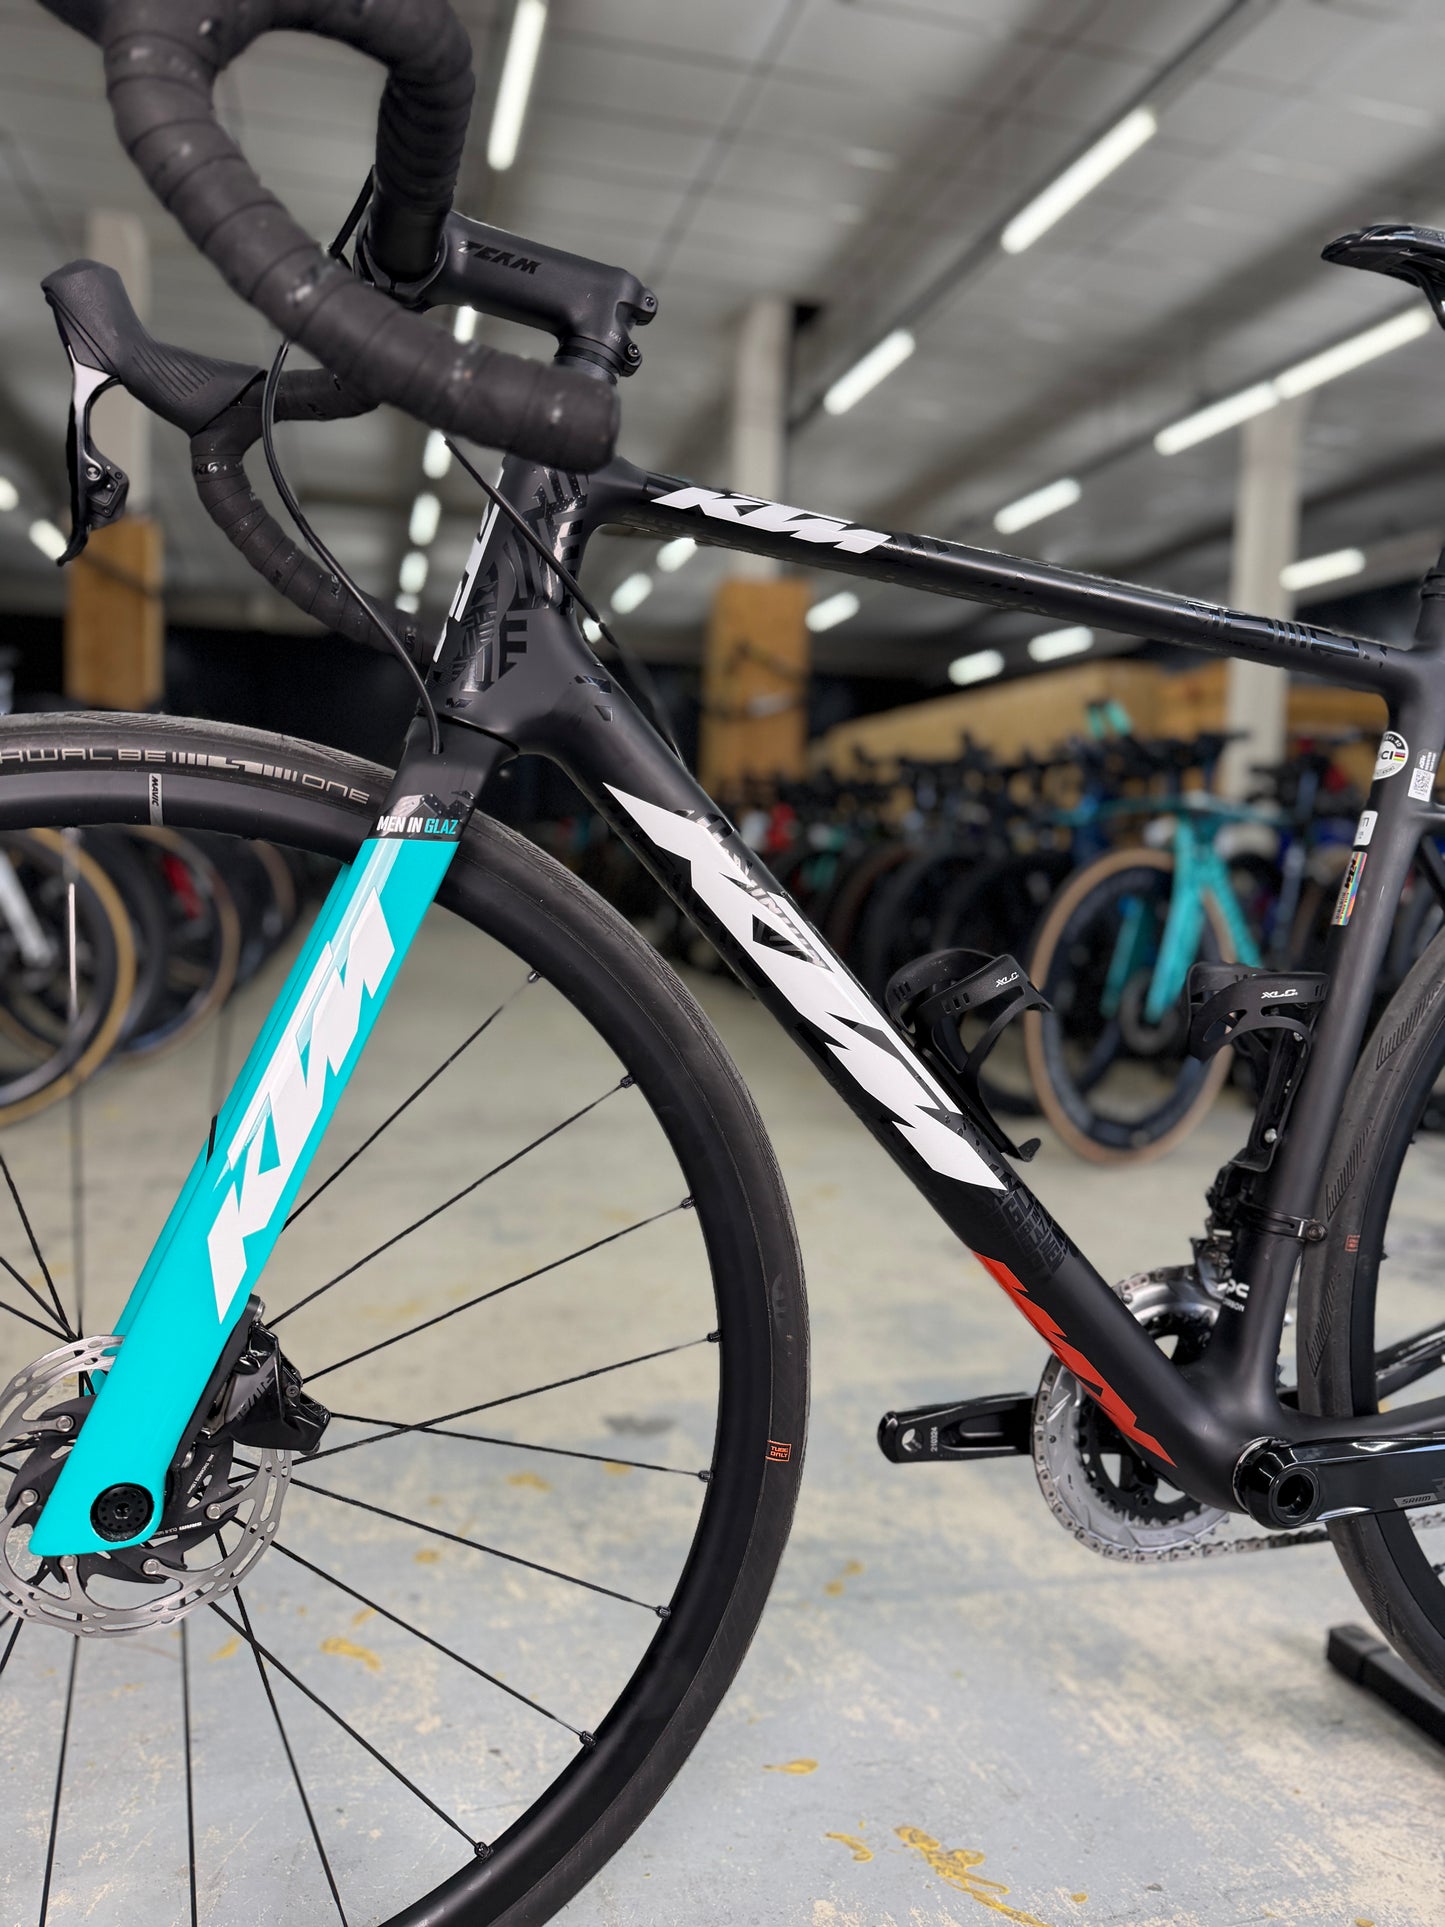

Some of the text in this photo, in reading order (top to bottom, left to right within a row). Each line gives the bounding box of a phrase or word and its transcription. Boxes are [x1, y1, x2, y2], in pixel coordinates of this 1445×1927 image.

[650, 487, 892, 553] KTM
[151, 776, 159, 806] MAVIC
[302, 774, 370, 804] ONE
[376, 815, 459, 835] MEN IN GLAZ
[602, 782, 1008, 1190] KTM
[995, 971, 1020, 988] XLC
[1260, 988, 1299, 1000] XLC
[207, 886, 395, 1324] KTM
[770, 1445, 789, 1453] TUBE
[770, 1450, 787, 1458] ONLY
